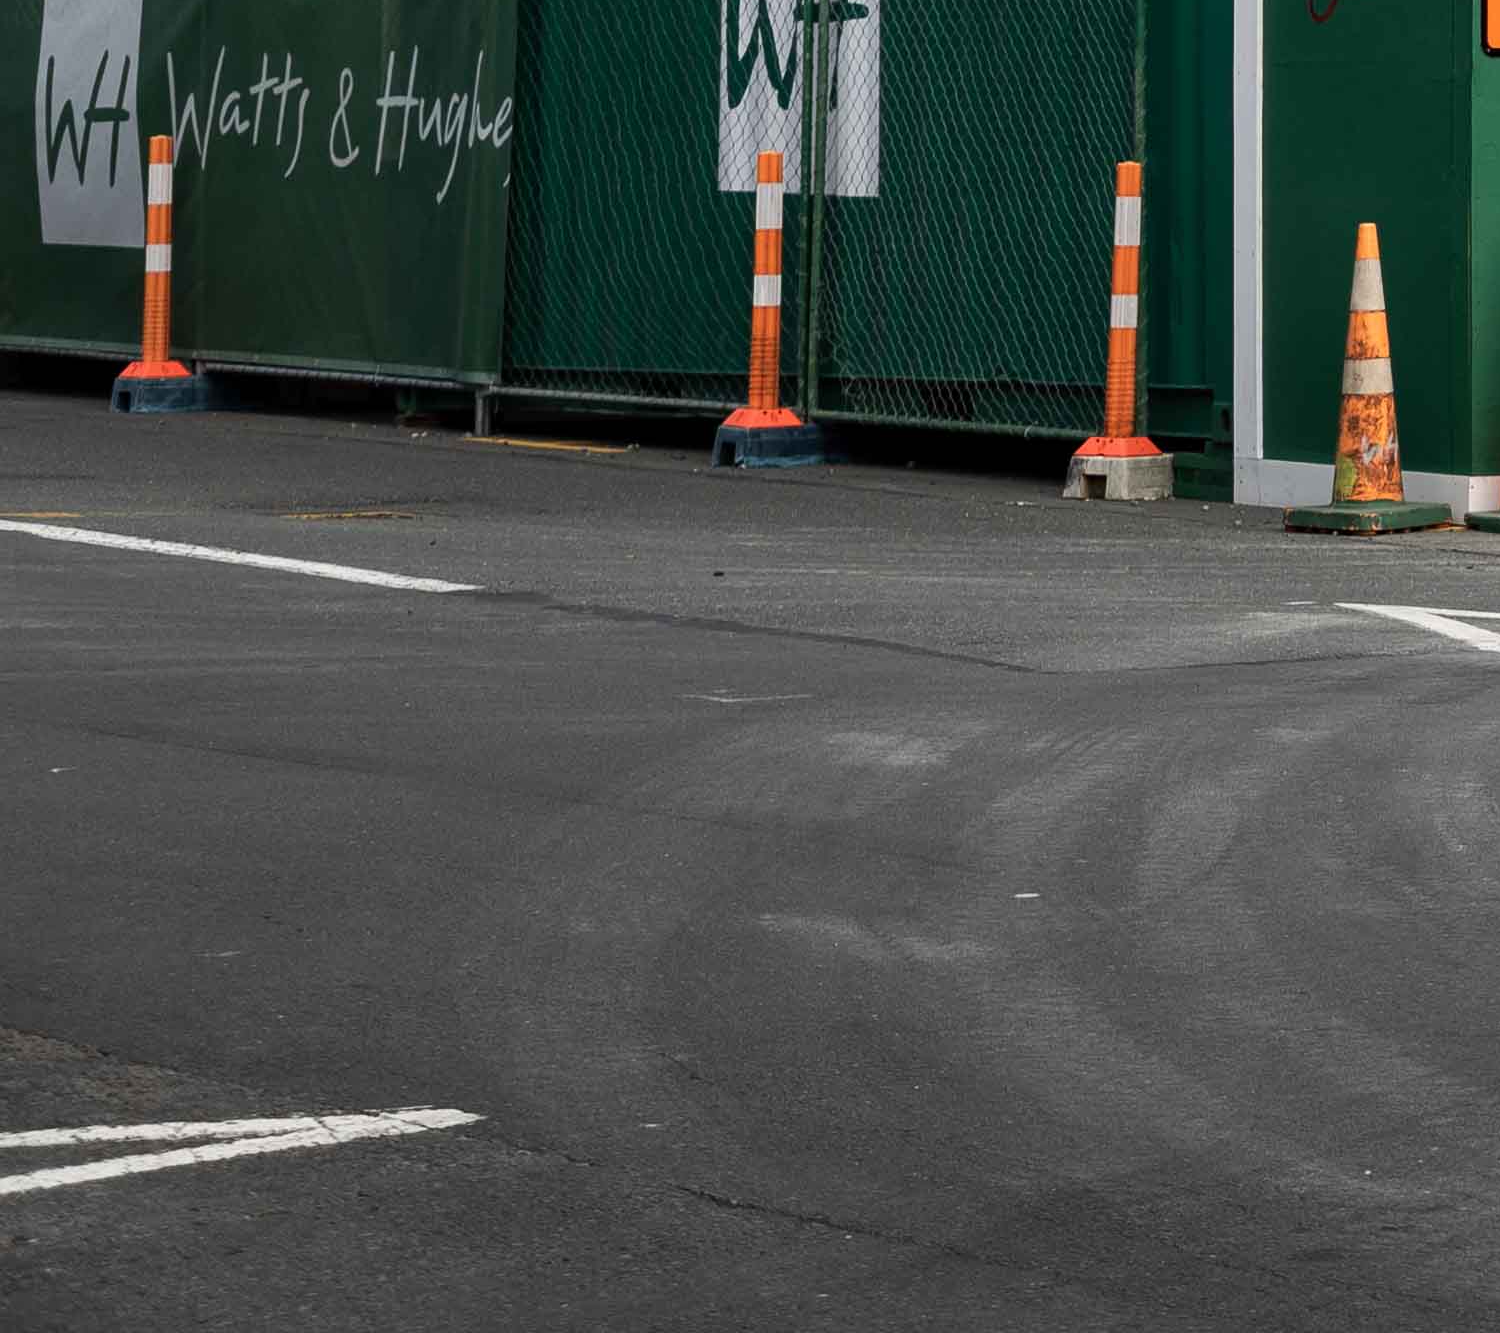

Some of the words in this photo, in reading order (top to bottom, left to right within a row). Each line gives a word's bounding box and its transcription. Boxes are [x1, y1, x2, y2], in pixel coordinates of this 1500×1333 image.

[47, 49, 131, 188] WH
[167, 45, 311, 179] Watts
[329, 67, 360, 168] &
[376, 44, 514, 205] Hughe
